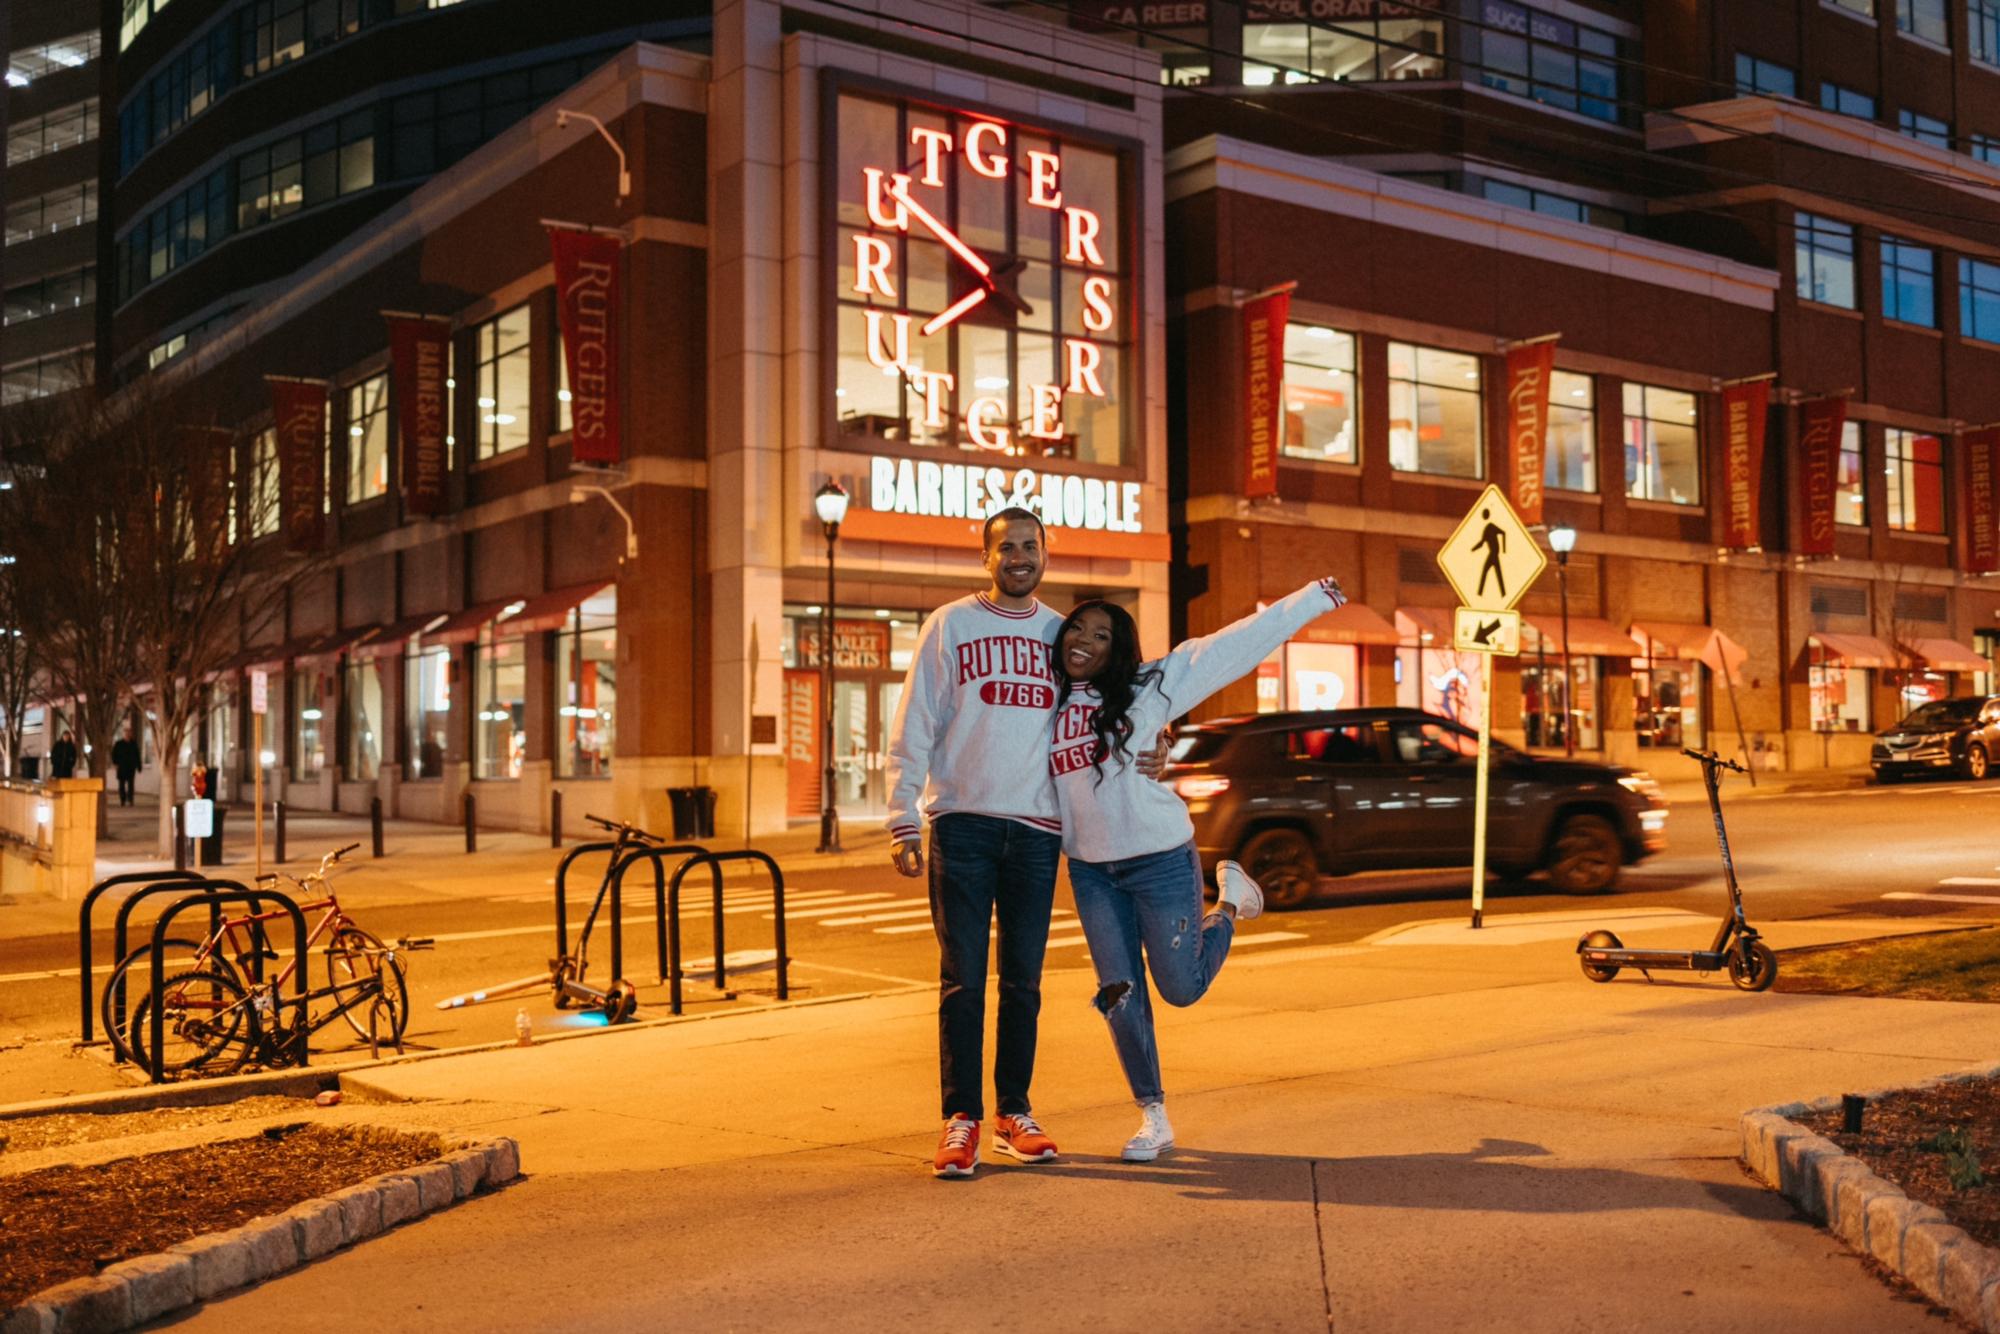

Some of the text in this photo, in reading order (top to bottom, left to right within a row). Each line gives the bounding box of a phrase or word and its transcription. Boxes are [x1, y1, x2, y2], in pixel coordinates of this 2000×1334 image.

[566, 260, 612, 440] RUTGERS
[1508, 366, 1541, 509] RUTGERS
[1801, 416, 1831, 541] RUTGERS
[791, 679, 813, 763] PRIDE
[993, 682, 1044, 707] 1766
